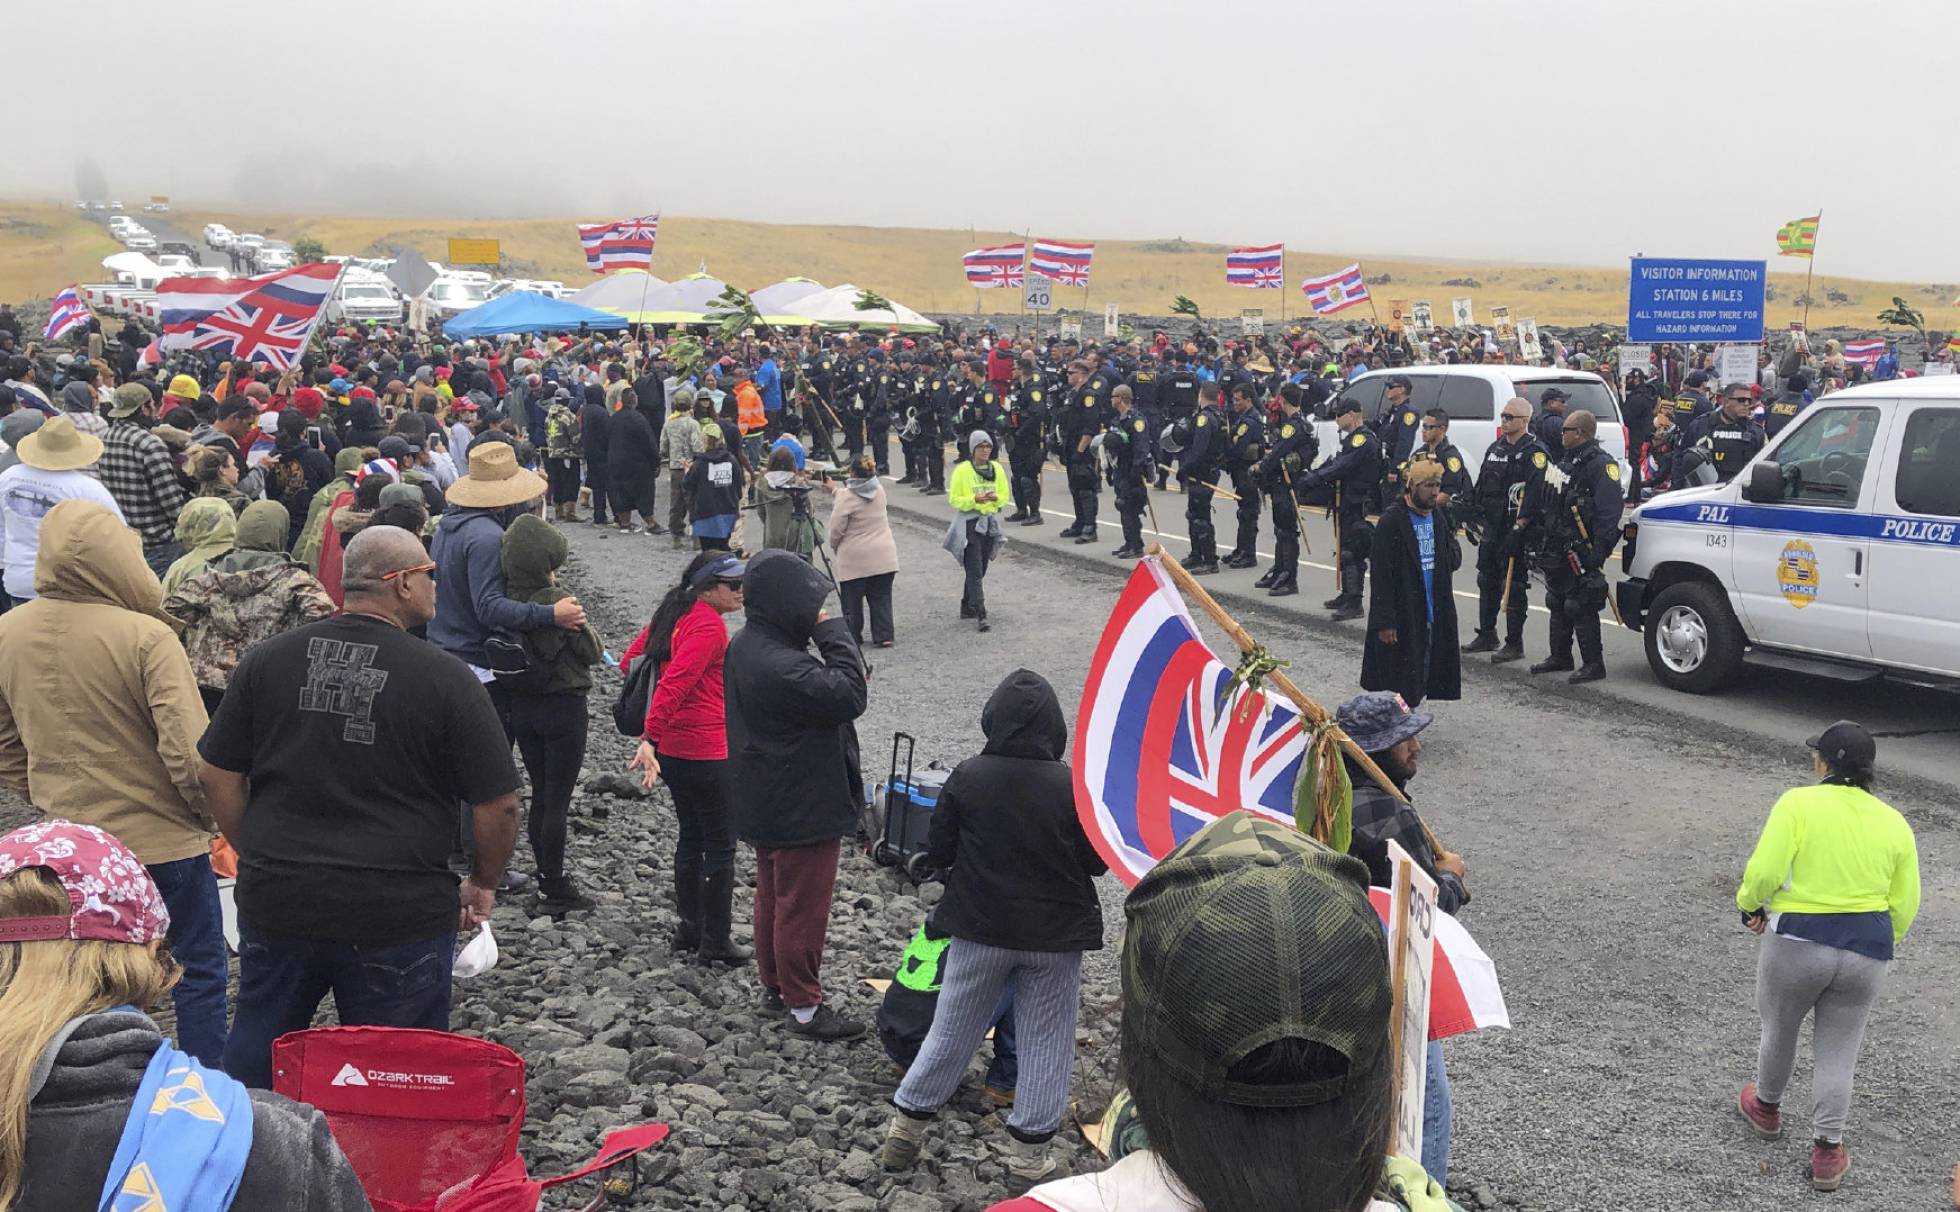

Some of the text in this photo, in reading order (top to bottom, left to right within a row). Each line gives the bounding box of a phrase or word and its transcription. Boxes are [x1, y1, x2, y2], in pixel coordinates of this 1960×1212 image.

[1641, 267, 1758, 281] VISITOR INFORMATION
[1028, 293, 1049, 305] 40
[1653, 289, 1744, 302] STATION 6 MILES
[1635, 310, 1758, 319] ALL TRAVELERS STOP THERE FOR
[1656, 324, 1737, 333] HAZARD INFORMATION
[1713, 431, 1742, 439] POLICE
[1697, 505, 1729, 523] PAL
[1881, 519, 1956, 542] POLICE
[1706, 534, 1727, 548] 1343
[1782, 584, 1816, 596] POLICE
[368, 1069, 455, 1085] OZARK TRAIL
